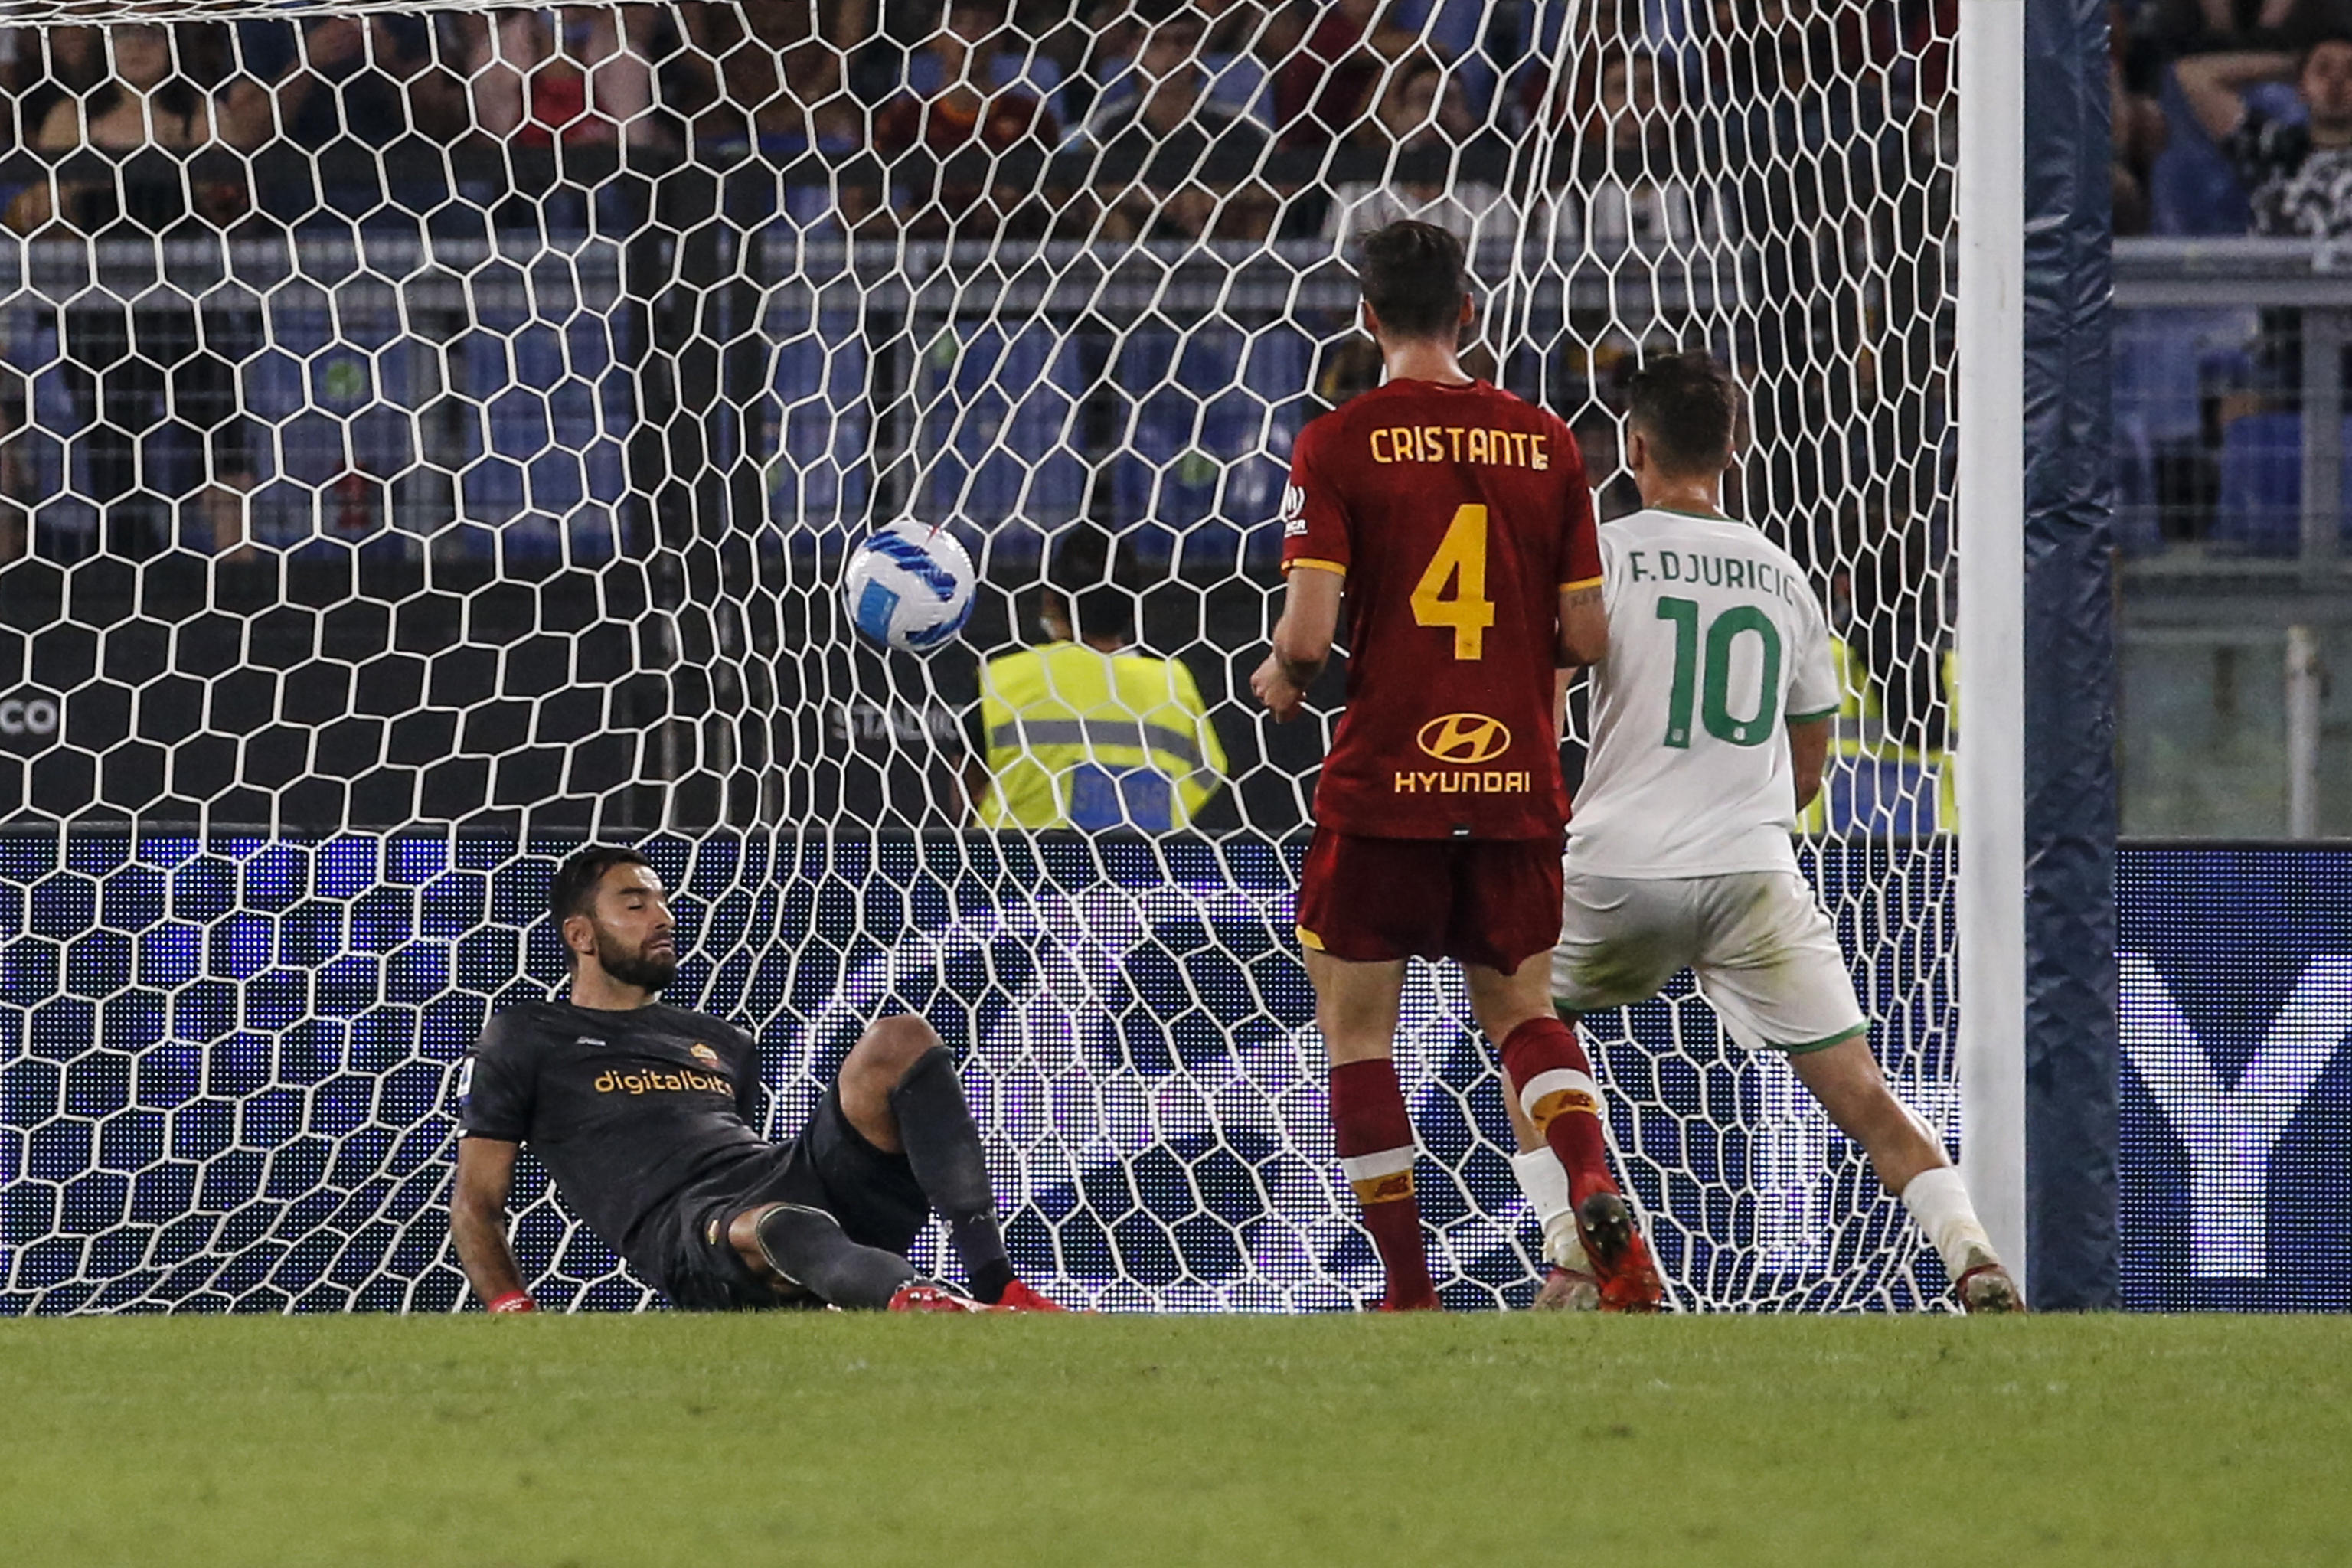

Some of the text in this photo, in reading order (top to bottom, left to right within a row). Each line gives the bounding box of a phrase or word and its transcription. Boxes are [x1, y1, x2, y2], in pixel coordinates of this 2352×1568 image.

[1370, 426, 1549, 470] CRISTANTE
[1410, 503, 1495, 661] 4
[1656, 596, 1782, 750] 10
[1394, 771, 1530, 793] HYUNDAI
